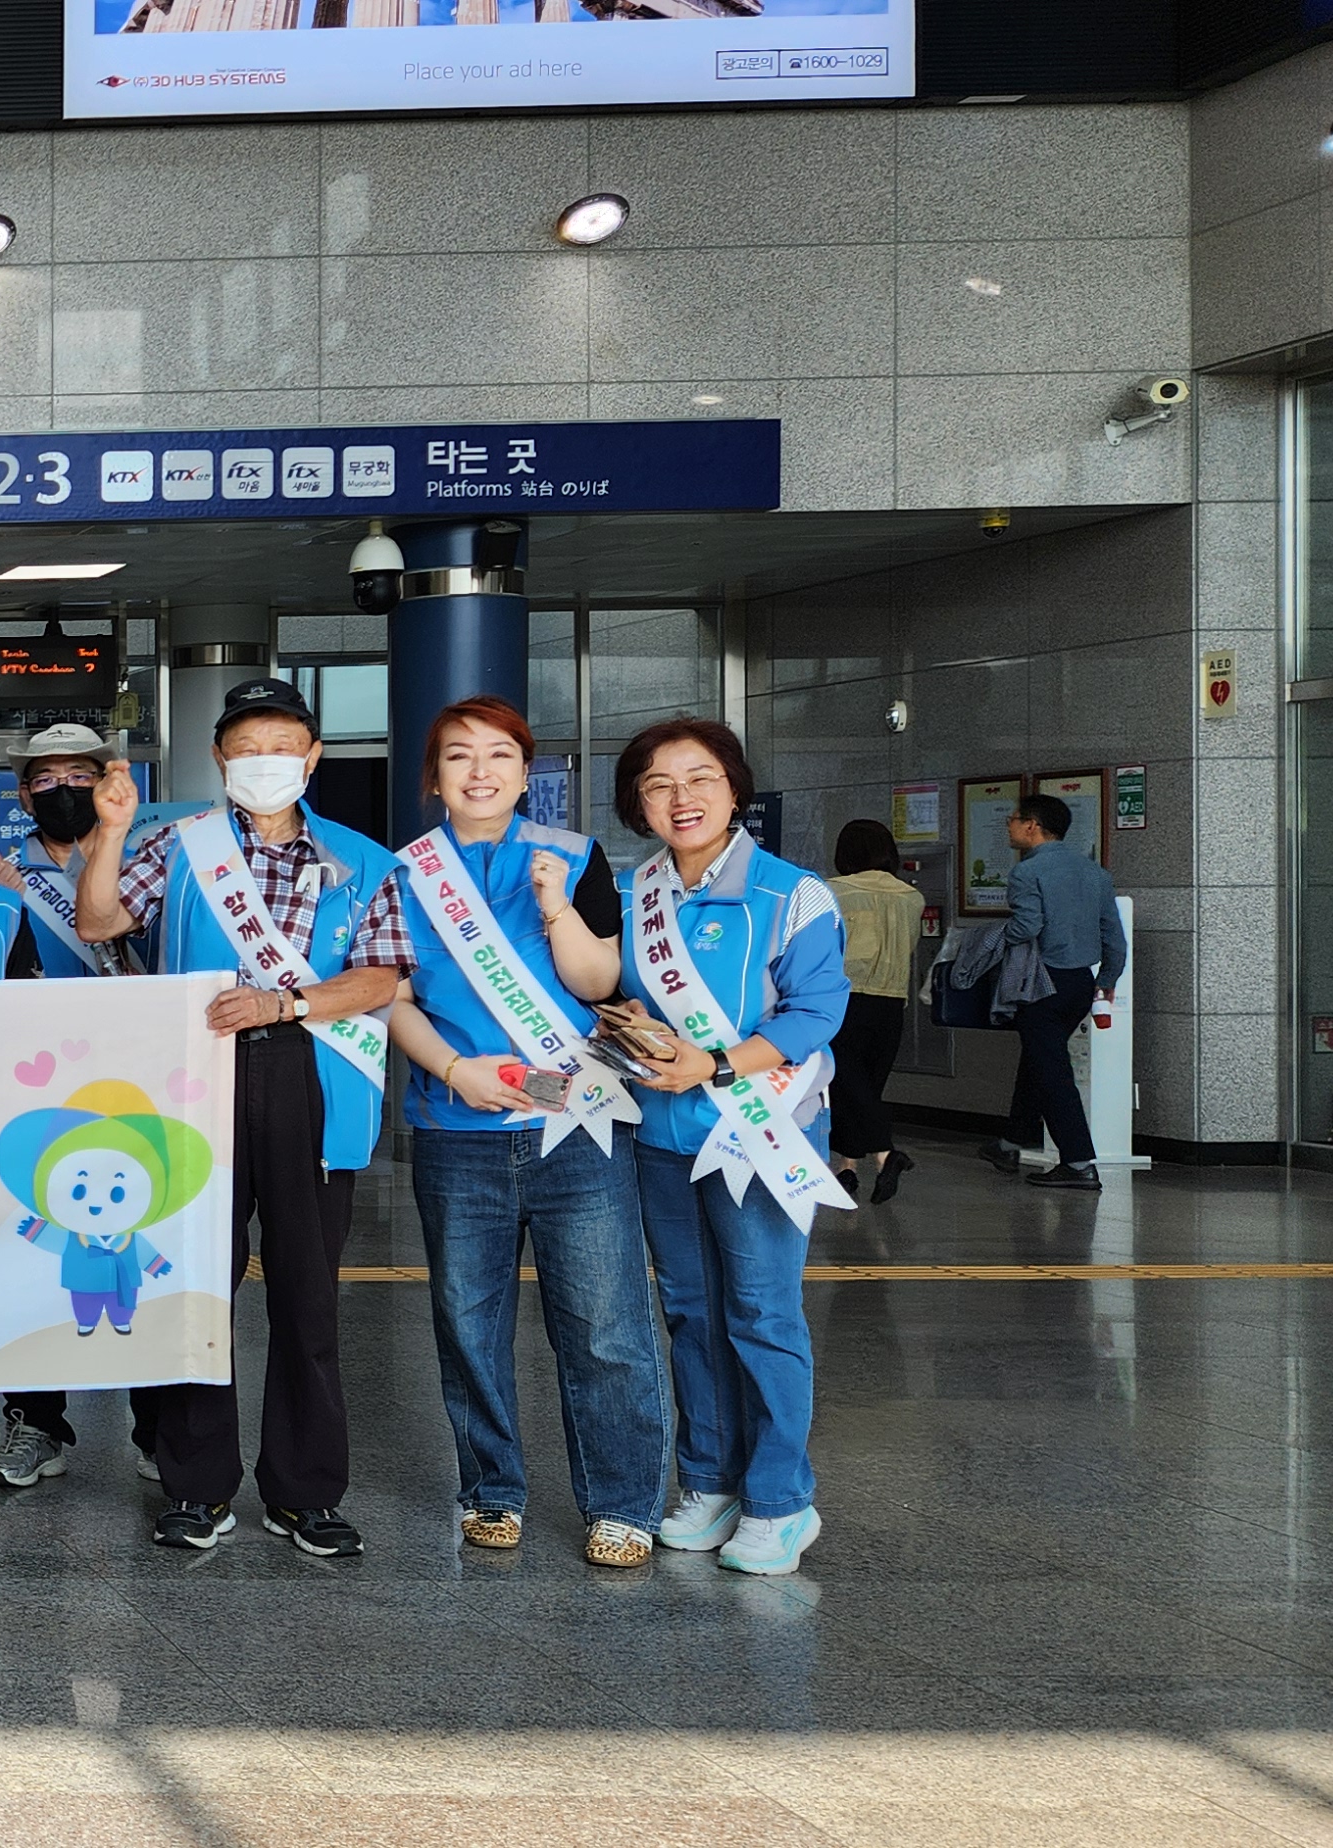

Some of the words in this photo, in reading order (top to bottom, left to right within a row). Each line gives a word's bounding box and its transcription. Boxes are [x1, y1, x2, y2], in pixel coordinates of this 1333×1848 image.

[722, 57, 773, 71] 광고문의
[803, 54, 882, 69] 1600-1029
[151, 76, 171, 87] 3D
[209, 72, 286, 86] SYSTEMS
[403, 62, 454, 82] Place
[459, 63, 502, 84] your
[508, 61, 532, 78] ad
[539, 59, 582, 77] here
[427, 440, 488, 475] 타는
[507, 439, 537, 474] 곳
[107, 467, 148, 484] KTX
[165, 466, 201, 481] KTX
[227, 461, 273, 479] itx
[287, 461, 333, 479] itx
[348, 460, 391, 476] 무궁화
[238, 482, 260, 492] 마음
[292, 481, 321, 491] 새마을
[426, 480, 512, 498] Platforms
[520, 481, 554, 497] 站台
[561, 480, 610, 496] のりば
[1209, 659, 1231, 669] AED
[407, 838, 446, 877] 매월
